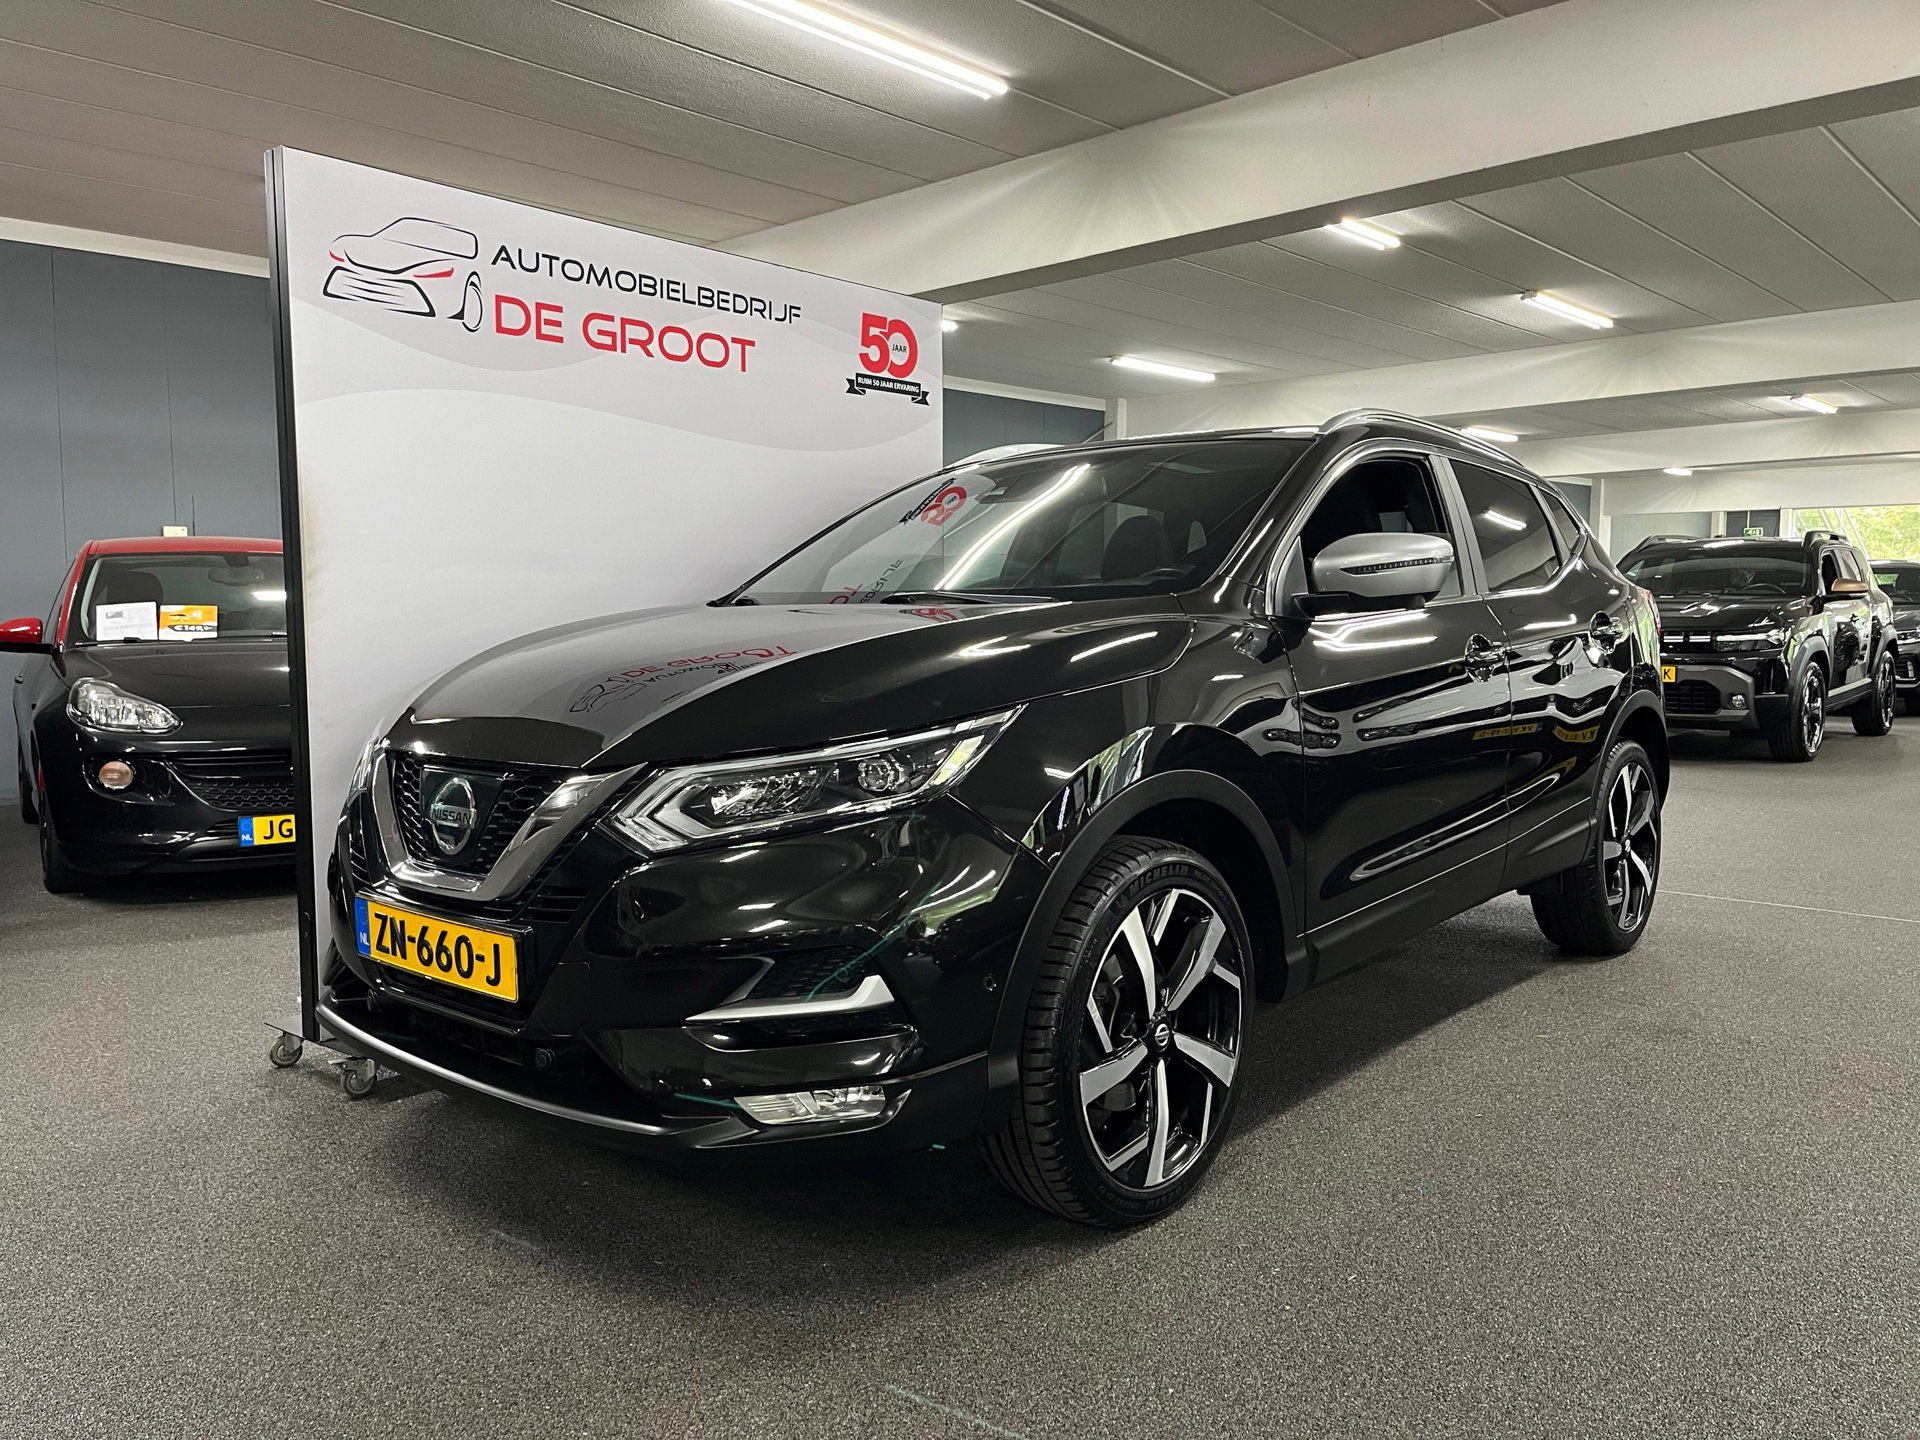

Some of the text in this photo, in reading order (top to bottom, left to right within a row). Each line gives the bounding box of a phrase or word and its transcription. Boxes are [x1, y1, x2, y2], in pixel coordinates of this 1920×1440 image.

[491, 244, 802, 325] AUTOMOBIELBEDRIJF
[495, 294, 756, 373] DE GROOT
[859, 312, 918, 378] 50
[892, 344, 908, 353] JAAR
[858, 377, 872, 385] RUIM
[880, 380, 894, 388] JAAR
[894, 383, 919, 393] ERVARING
[431, 809, 471, 825] NISSAN
[1128, 864, 1189, 897] MICHELIN
[359, 912, 501, 987] NL ZN-660-J
